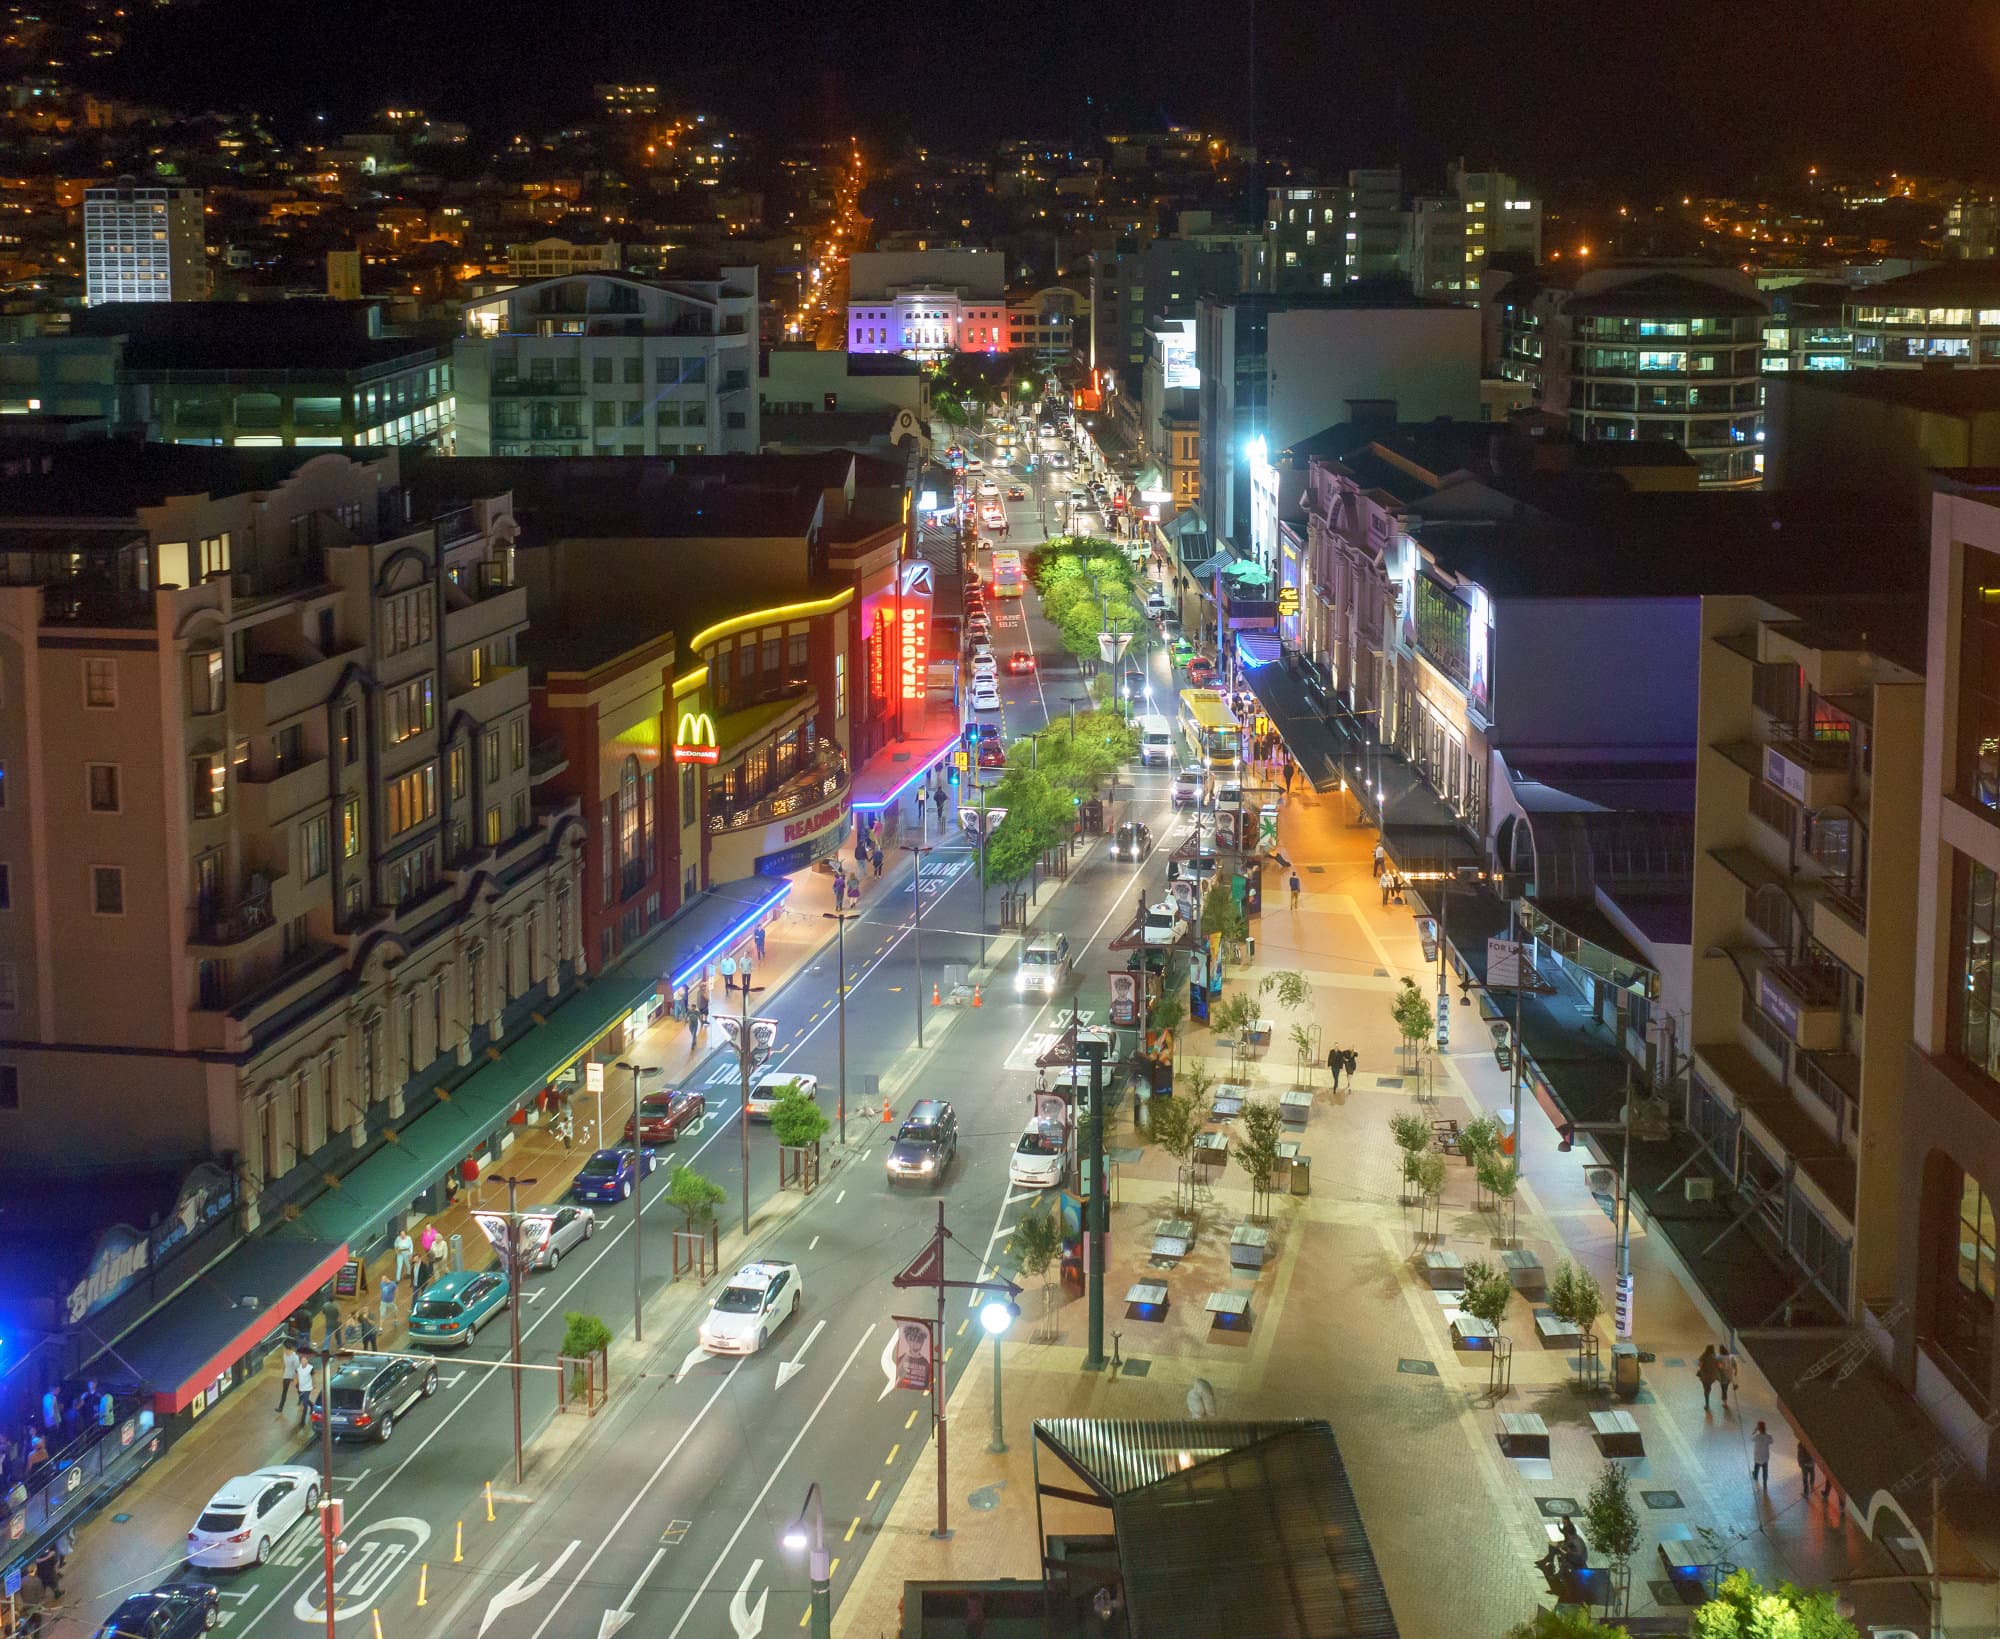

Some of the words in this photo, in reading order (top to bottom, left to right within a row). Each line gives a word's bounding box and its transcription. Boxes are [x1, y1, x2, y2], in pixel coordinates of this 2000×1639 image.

[902, 608, 916, 698] READING
[916, 609, 925, 698] CINEMAS
[1489, 942, 1506, 952] FOR
[323, 1542, 405, 1596] 30
